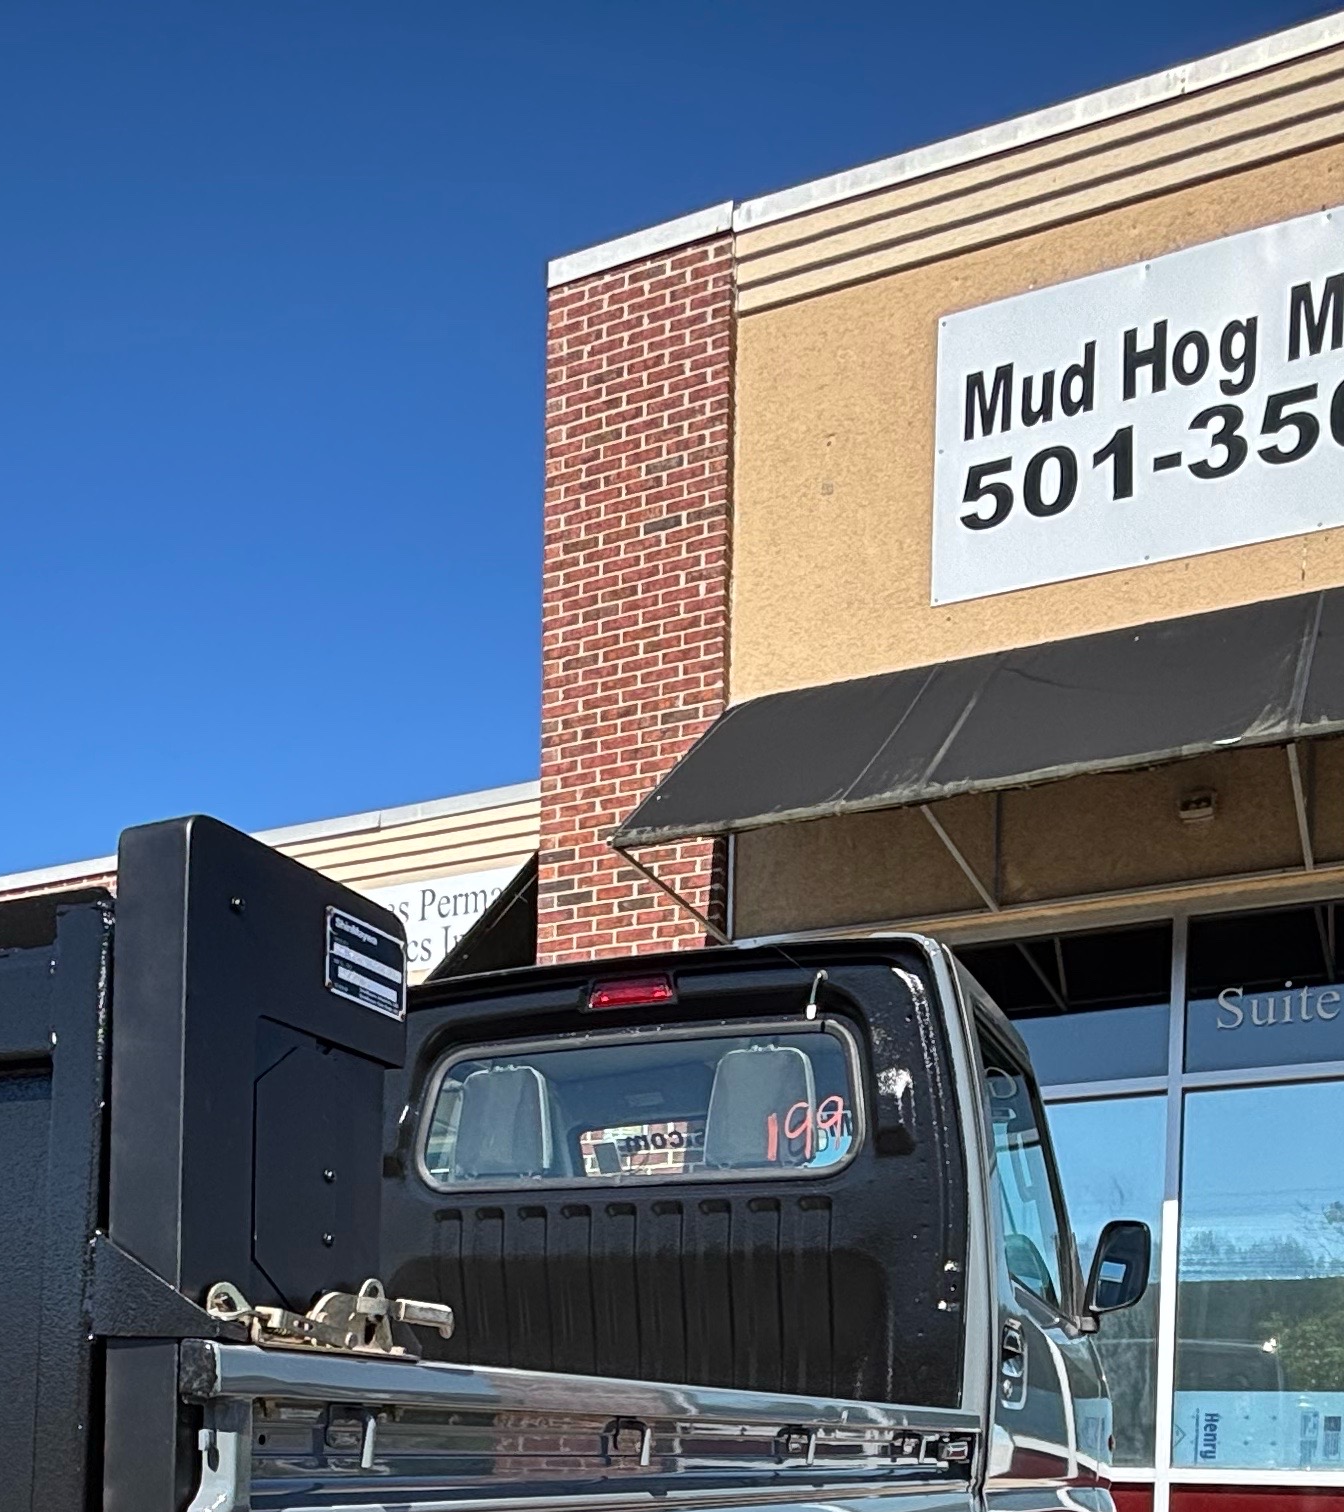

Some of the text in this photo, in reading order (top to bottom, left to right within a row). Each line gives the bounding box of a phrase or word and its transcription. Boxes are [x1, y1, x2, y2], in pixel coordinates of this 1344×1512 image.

[962, 340, 1096, 442] Mud
[1121, 314, 1260, 399] Hog
[1216, 980, 1341, 1030] Suite
[1199, 1412, 1219, 1460] Henry
